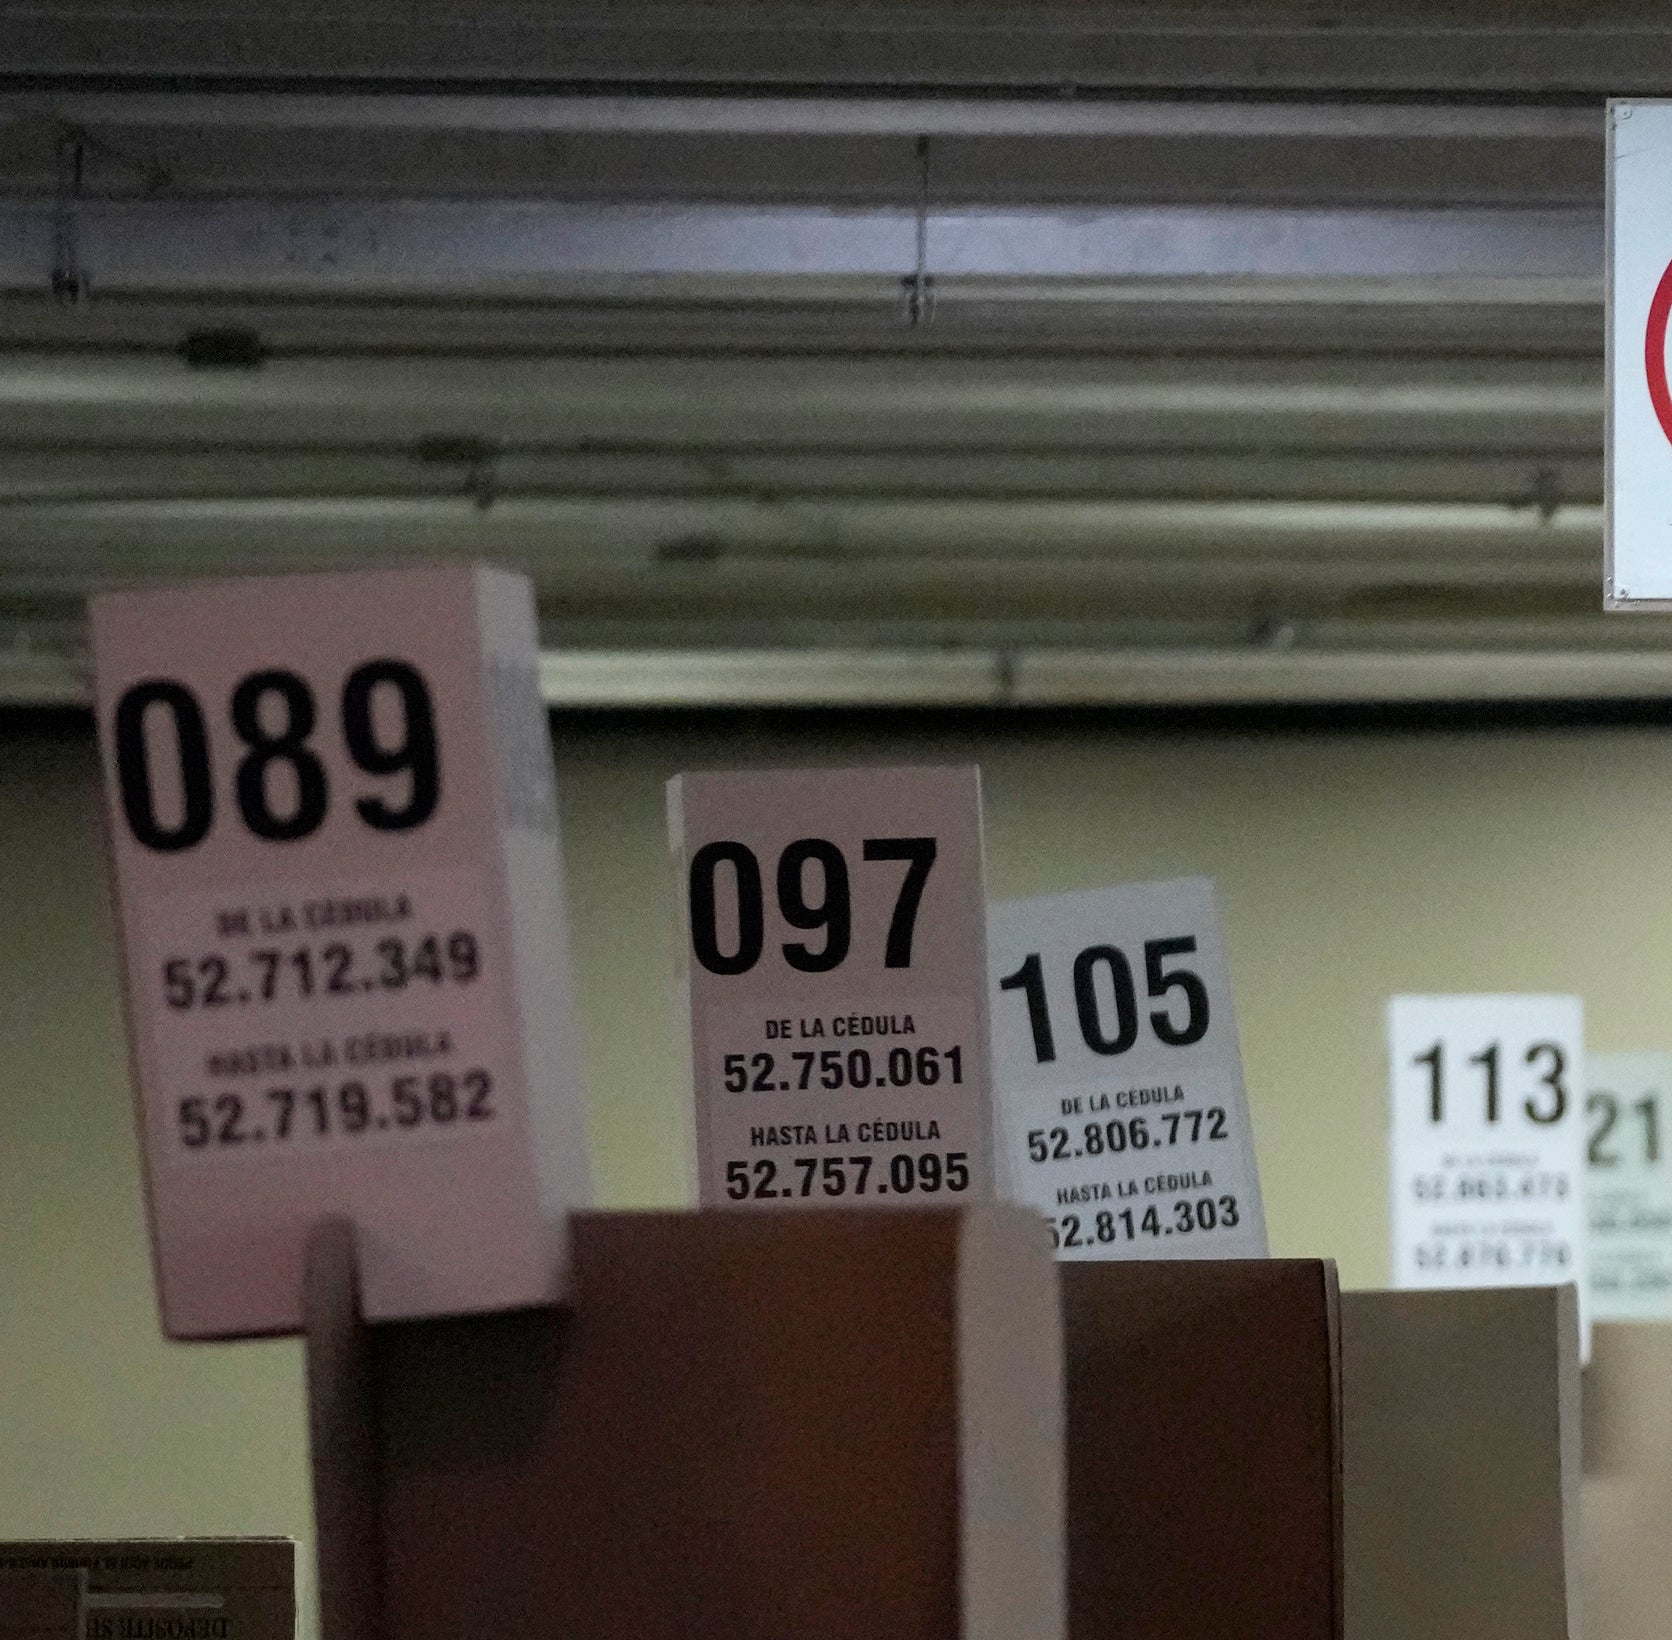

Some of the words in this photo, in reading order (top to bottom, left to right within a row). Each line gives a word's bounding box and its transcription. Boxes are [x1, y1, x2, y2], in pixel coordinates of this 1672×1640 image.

[114, 657, 440, 852] 089
[690, 836, 938, 976] 097
[162, 929, 480, 1011] 52.712.349
[766, 1018, 794, 1039] DE
[800, 1018, 826, 1039] LA
[832, 1008, 916, 1037] CÉDULA
[1000, 935, 1211, 1064] 105
[723, 1045, 964, 1093] 52.750.061
[1411, 1038, 1568, 1124] 113
[178, 1067, 495, 1150] 52.719.582
[750, 1123, 818, 1147] HASTA
[825, 1122, 853, 1146] LA
[858, 1115, 941, 1143] CÉDULA
[1060, 1096, 1084, 1116] DE
[1089, 1093, 1110, 1112] LA
[1028, 1106, 1230, 1163] 52.806.772
[725, 1152, 970, 1201] 52.757.095
[1056, 1183, 1112, 1206] HASTA
[1117, 1178, 1139, 1198] LA
